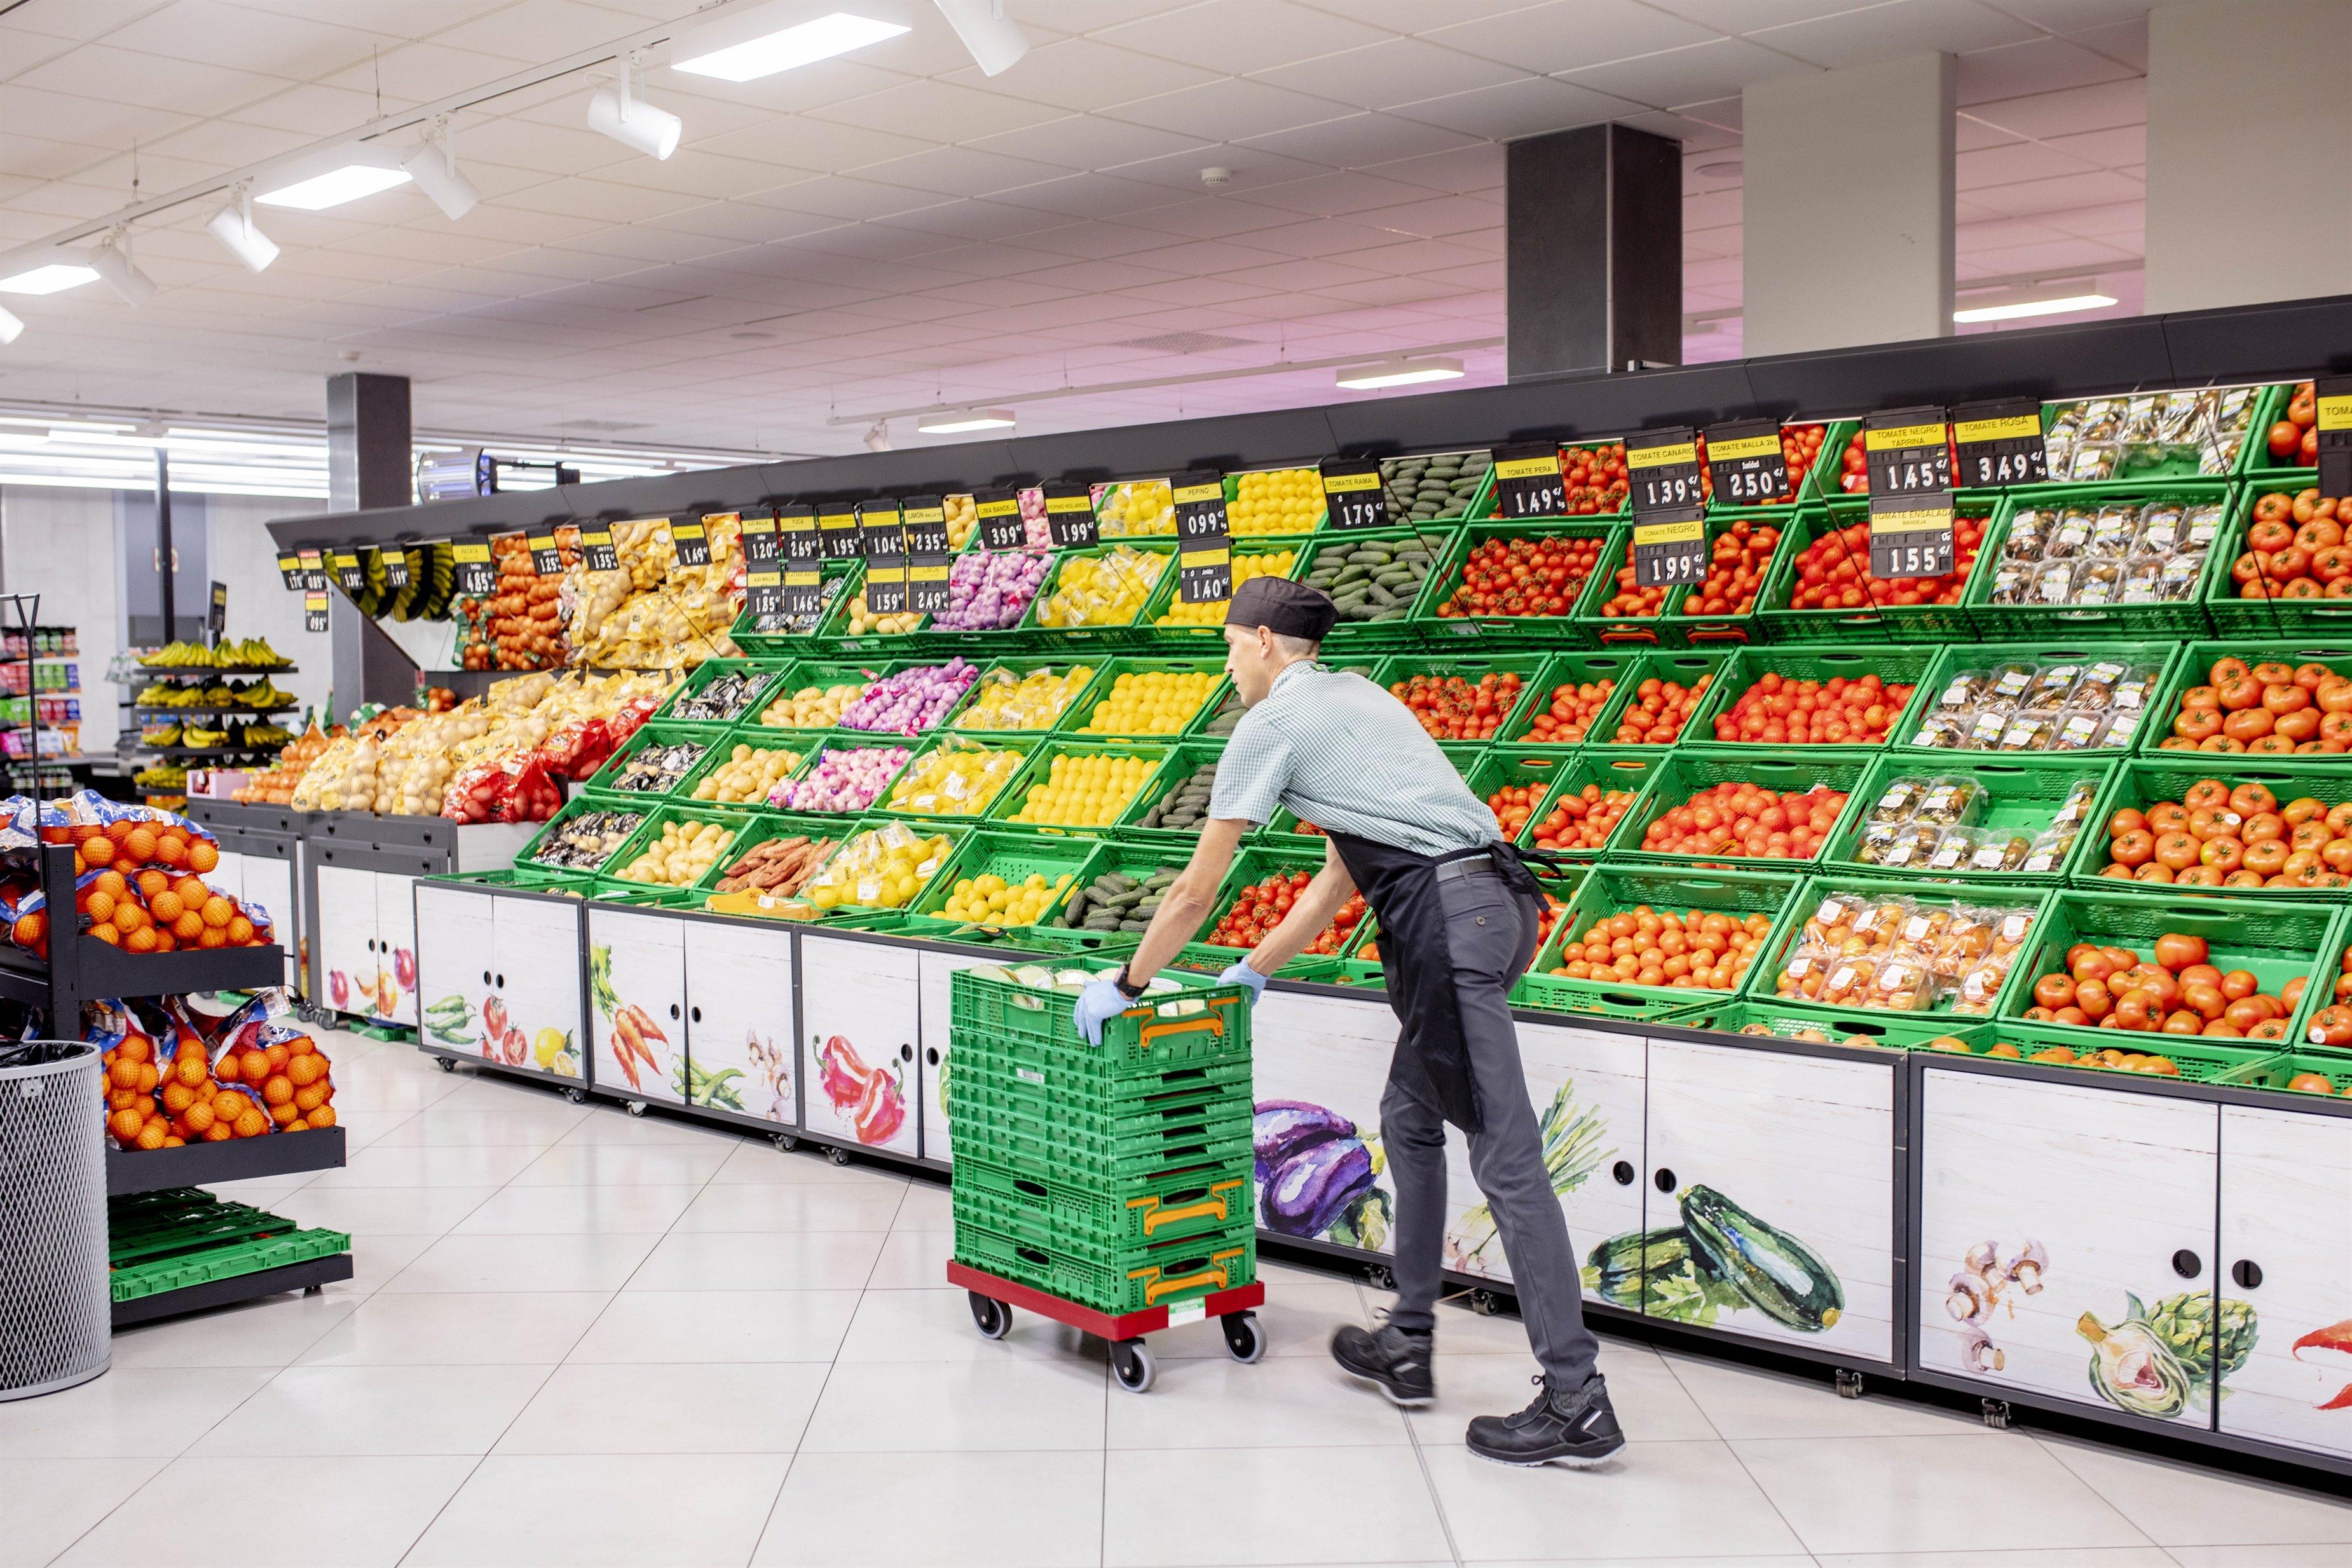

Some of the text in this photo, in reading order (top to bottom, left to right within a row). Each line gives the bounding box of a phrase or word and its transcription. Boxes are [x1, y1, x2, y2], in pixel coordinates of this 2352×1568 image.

[2324, 406, 2352, 416] TOM
[1964, 416, 2028, 432] TOMATE ROSA
[1876, 425, 1938, 439] TOMATE NEGRO
[1711, 443, 1740, 453] TOMATE
[1741, 440, 1765, 449] MALLA
[1891, 438, 1925, 447] TARRINA
[1632, 447, 1694, 460] TOMATE CANARIO
[1506, 468, 1533, 476] TOMATE
[1188, 487, 1209, 496] PEPINO
[1667, 524, 1695, 535] NEGRO
